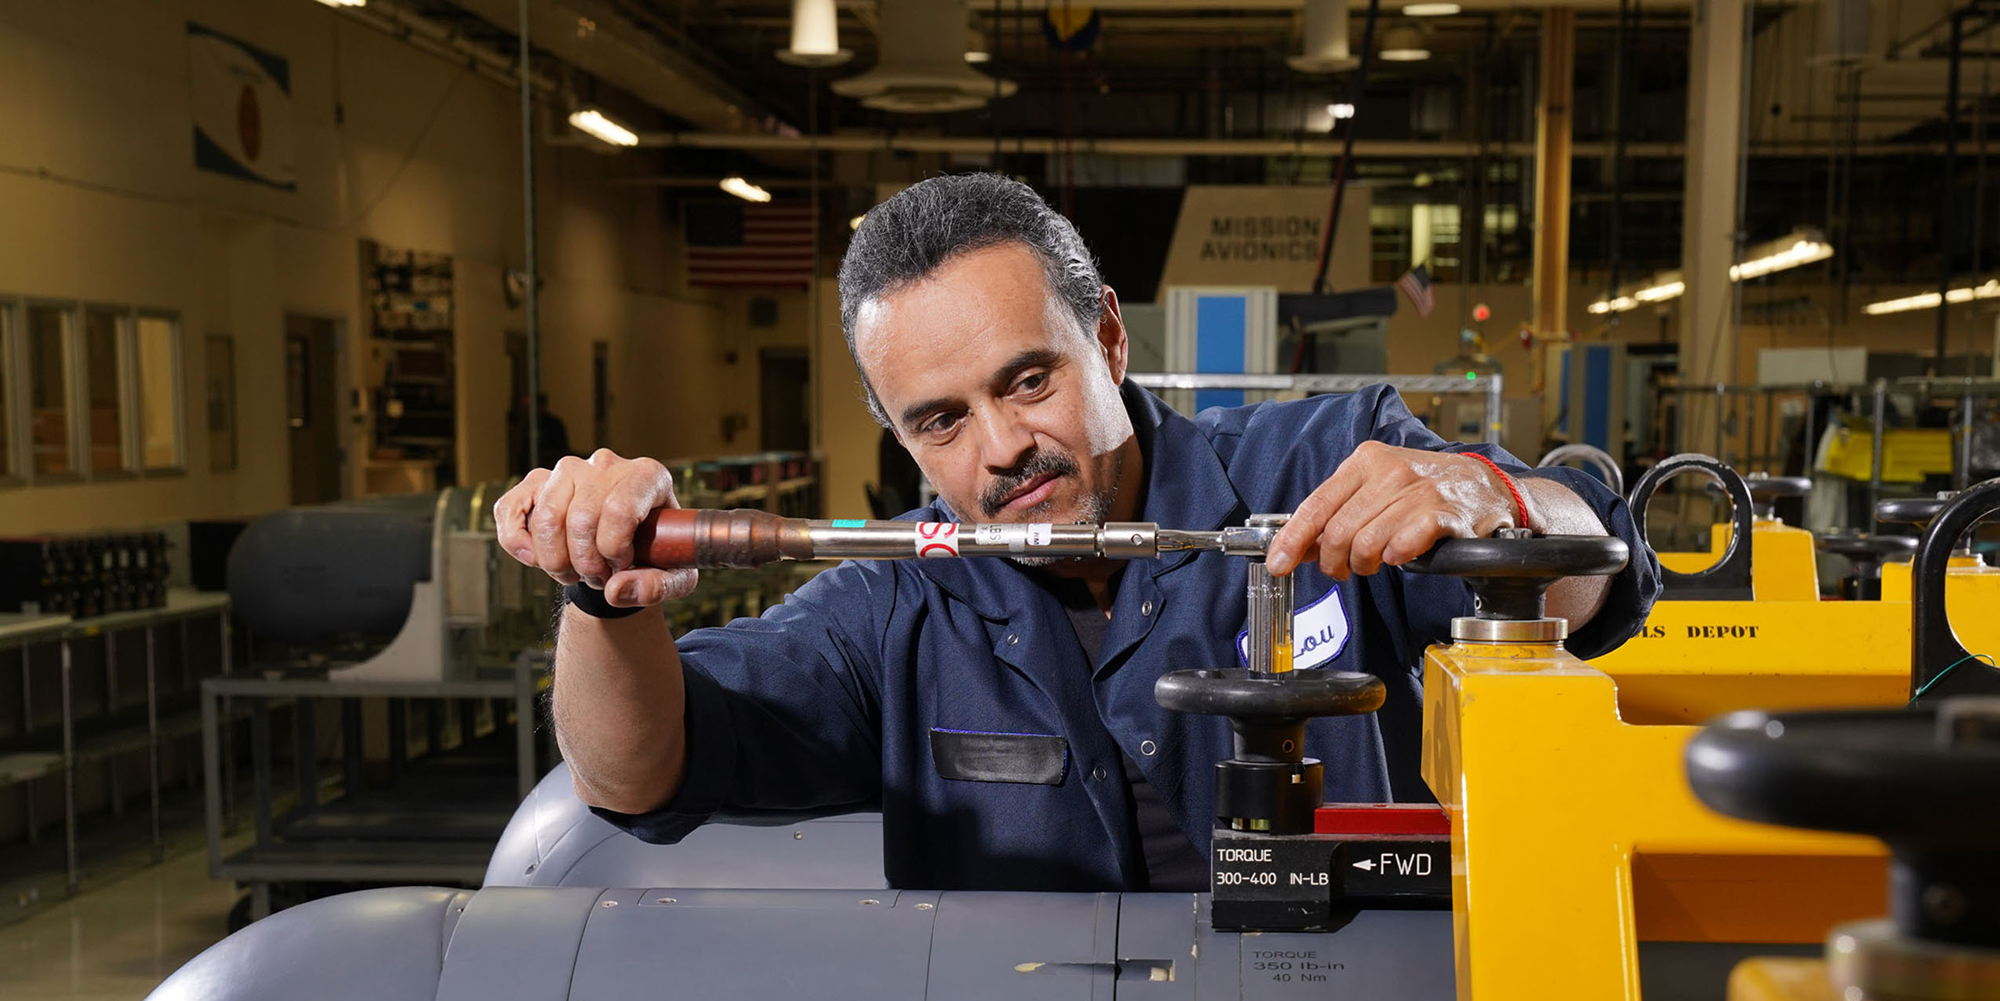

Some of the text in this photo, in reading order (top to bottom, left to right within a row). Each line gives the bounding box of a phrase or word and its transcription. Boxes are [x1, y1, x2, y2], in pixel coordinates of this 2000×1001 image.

[1211, 216, 1320, 236] MISSION
[1201, 240, 1320, 260] AVIONICS
[1636, 625, 1759, 638] LS DEPOT
[1293, 625, 1335, 659] ou
[1216, 849, 1272, 862] TORQUE
[1380, 853, 1432, 876] FWD
[1216, 872, 1329, 885] 300-400 IN-LB
[1253, 951, 1318, 959] TORQUE
[1254, 962, 1345, 971] 350 lb-in
[1273, 973, 1327, 982] 40 Nm
